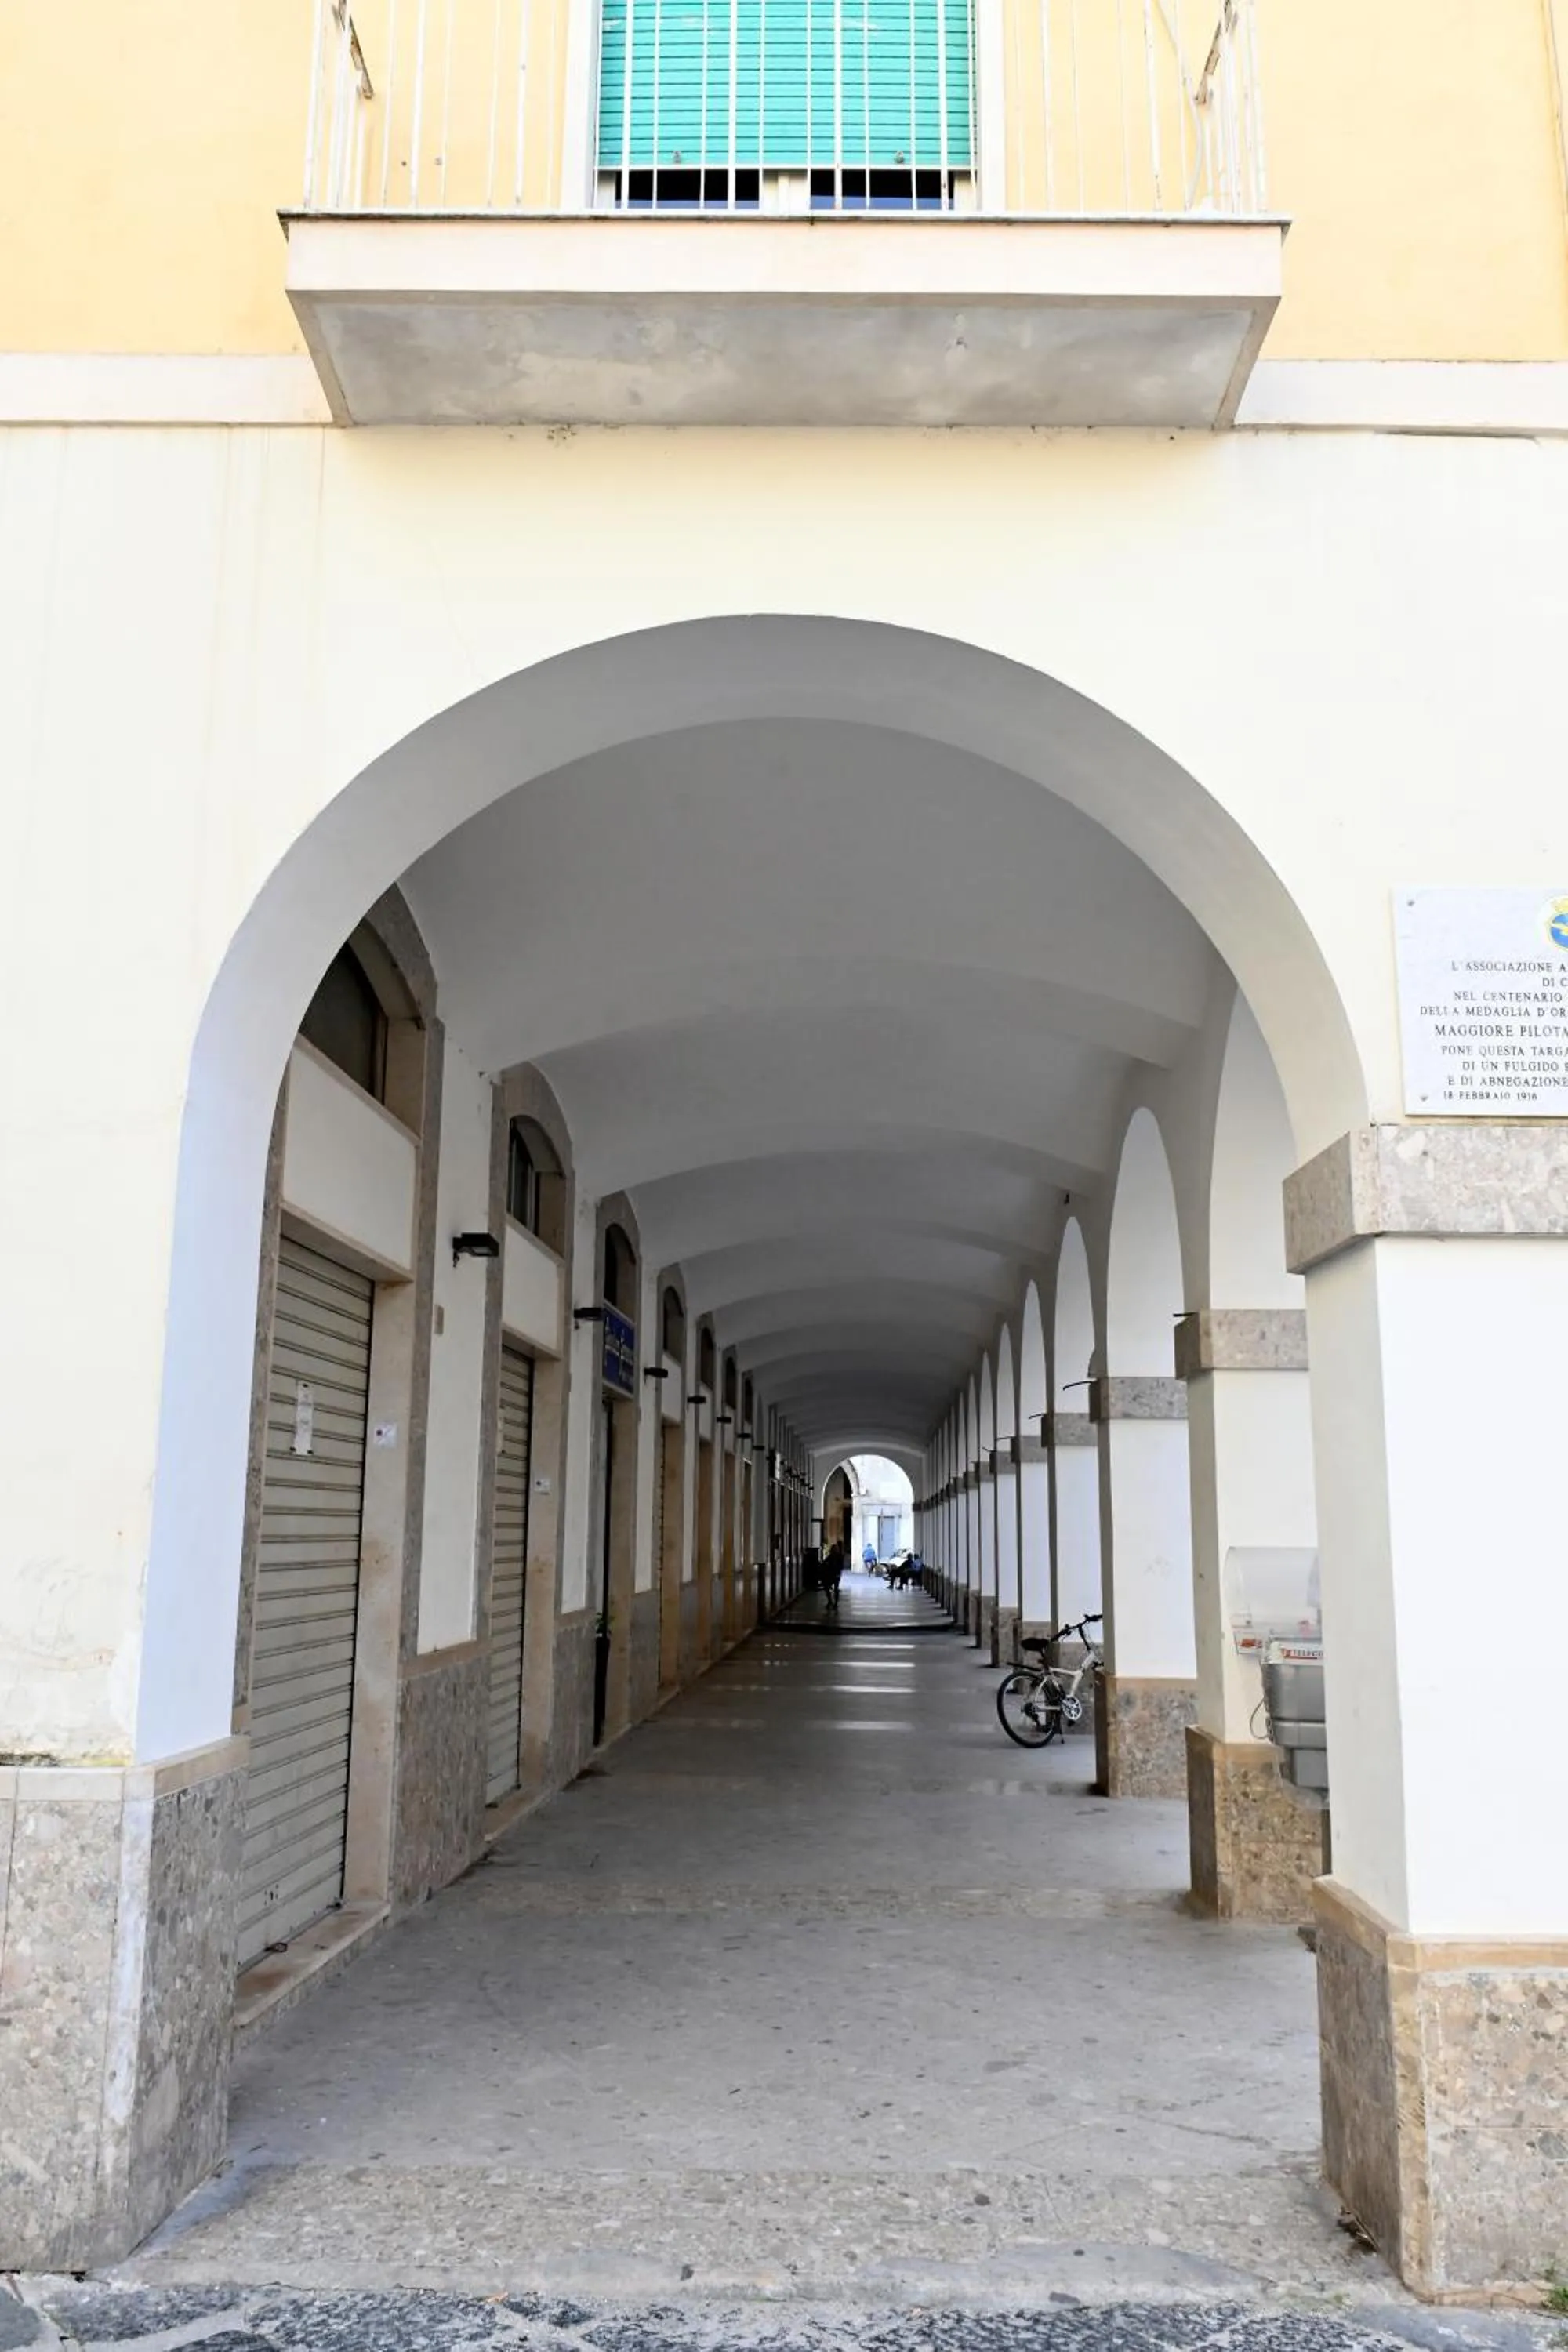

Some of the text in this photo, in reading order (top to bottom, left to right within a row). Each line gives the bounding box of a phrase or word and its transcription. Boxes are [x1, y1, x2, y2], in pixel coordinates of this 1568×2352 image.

[1542, 977, 1555, 987] DI
[1454, 990, 1563, 1003] NEL CENTENARIO
[1420, 1005, 1459, 1016] DELLA
[1465, 1005, 1530, 1017] MEDAGLIA
[1435, 1024, 1513, 1037] MAGGIORE
[1442, 1045, 1472, 1055] PONE
[1479, 1045, 1525, 1058] QUESTA
[1462, 1061, 1475, 1071] DI
[1481, 1061, 1497, 1071] UN
[1504, 1061, 1559, 1072] FULGIDO
[1448, 1076, 1568, 1087] E DI ABNEGAZIONE
[1459, 1091, 1511, 1101] FEBBRAIO
